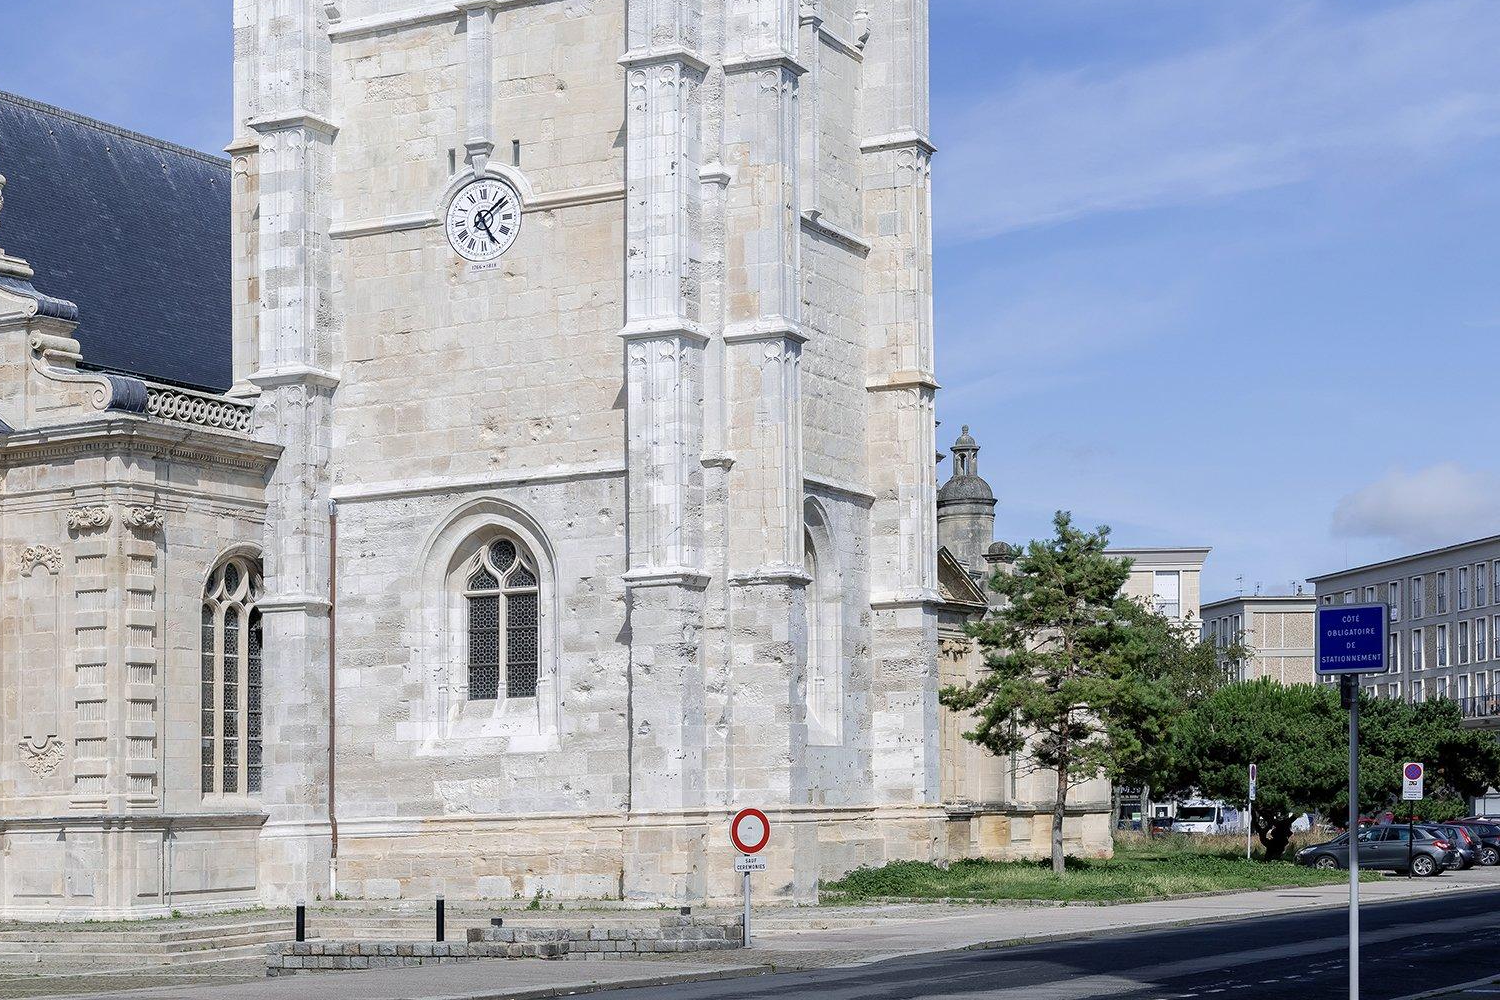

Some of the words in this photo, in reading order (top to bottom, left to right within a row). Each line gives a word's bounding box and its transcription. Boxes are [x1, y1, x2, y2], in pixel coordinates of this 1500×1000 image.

[1342, 614, 1360, 623] CÔTÉ
[1327, 627, 1376, 637] OBLIGATOIRE
[1346, 641, 1356, 649] DE
[1321, 653, 1381, 664] STATIONNEMENT
